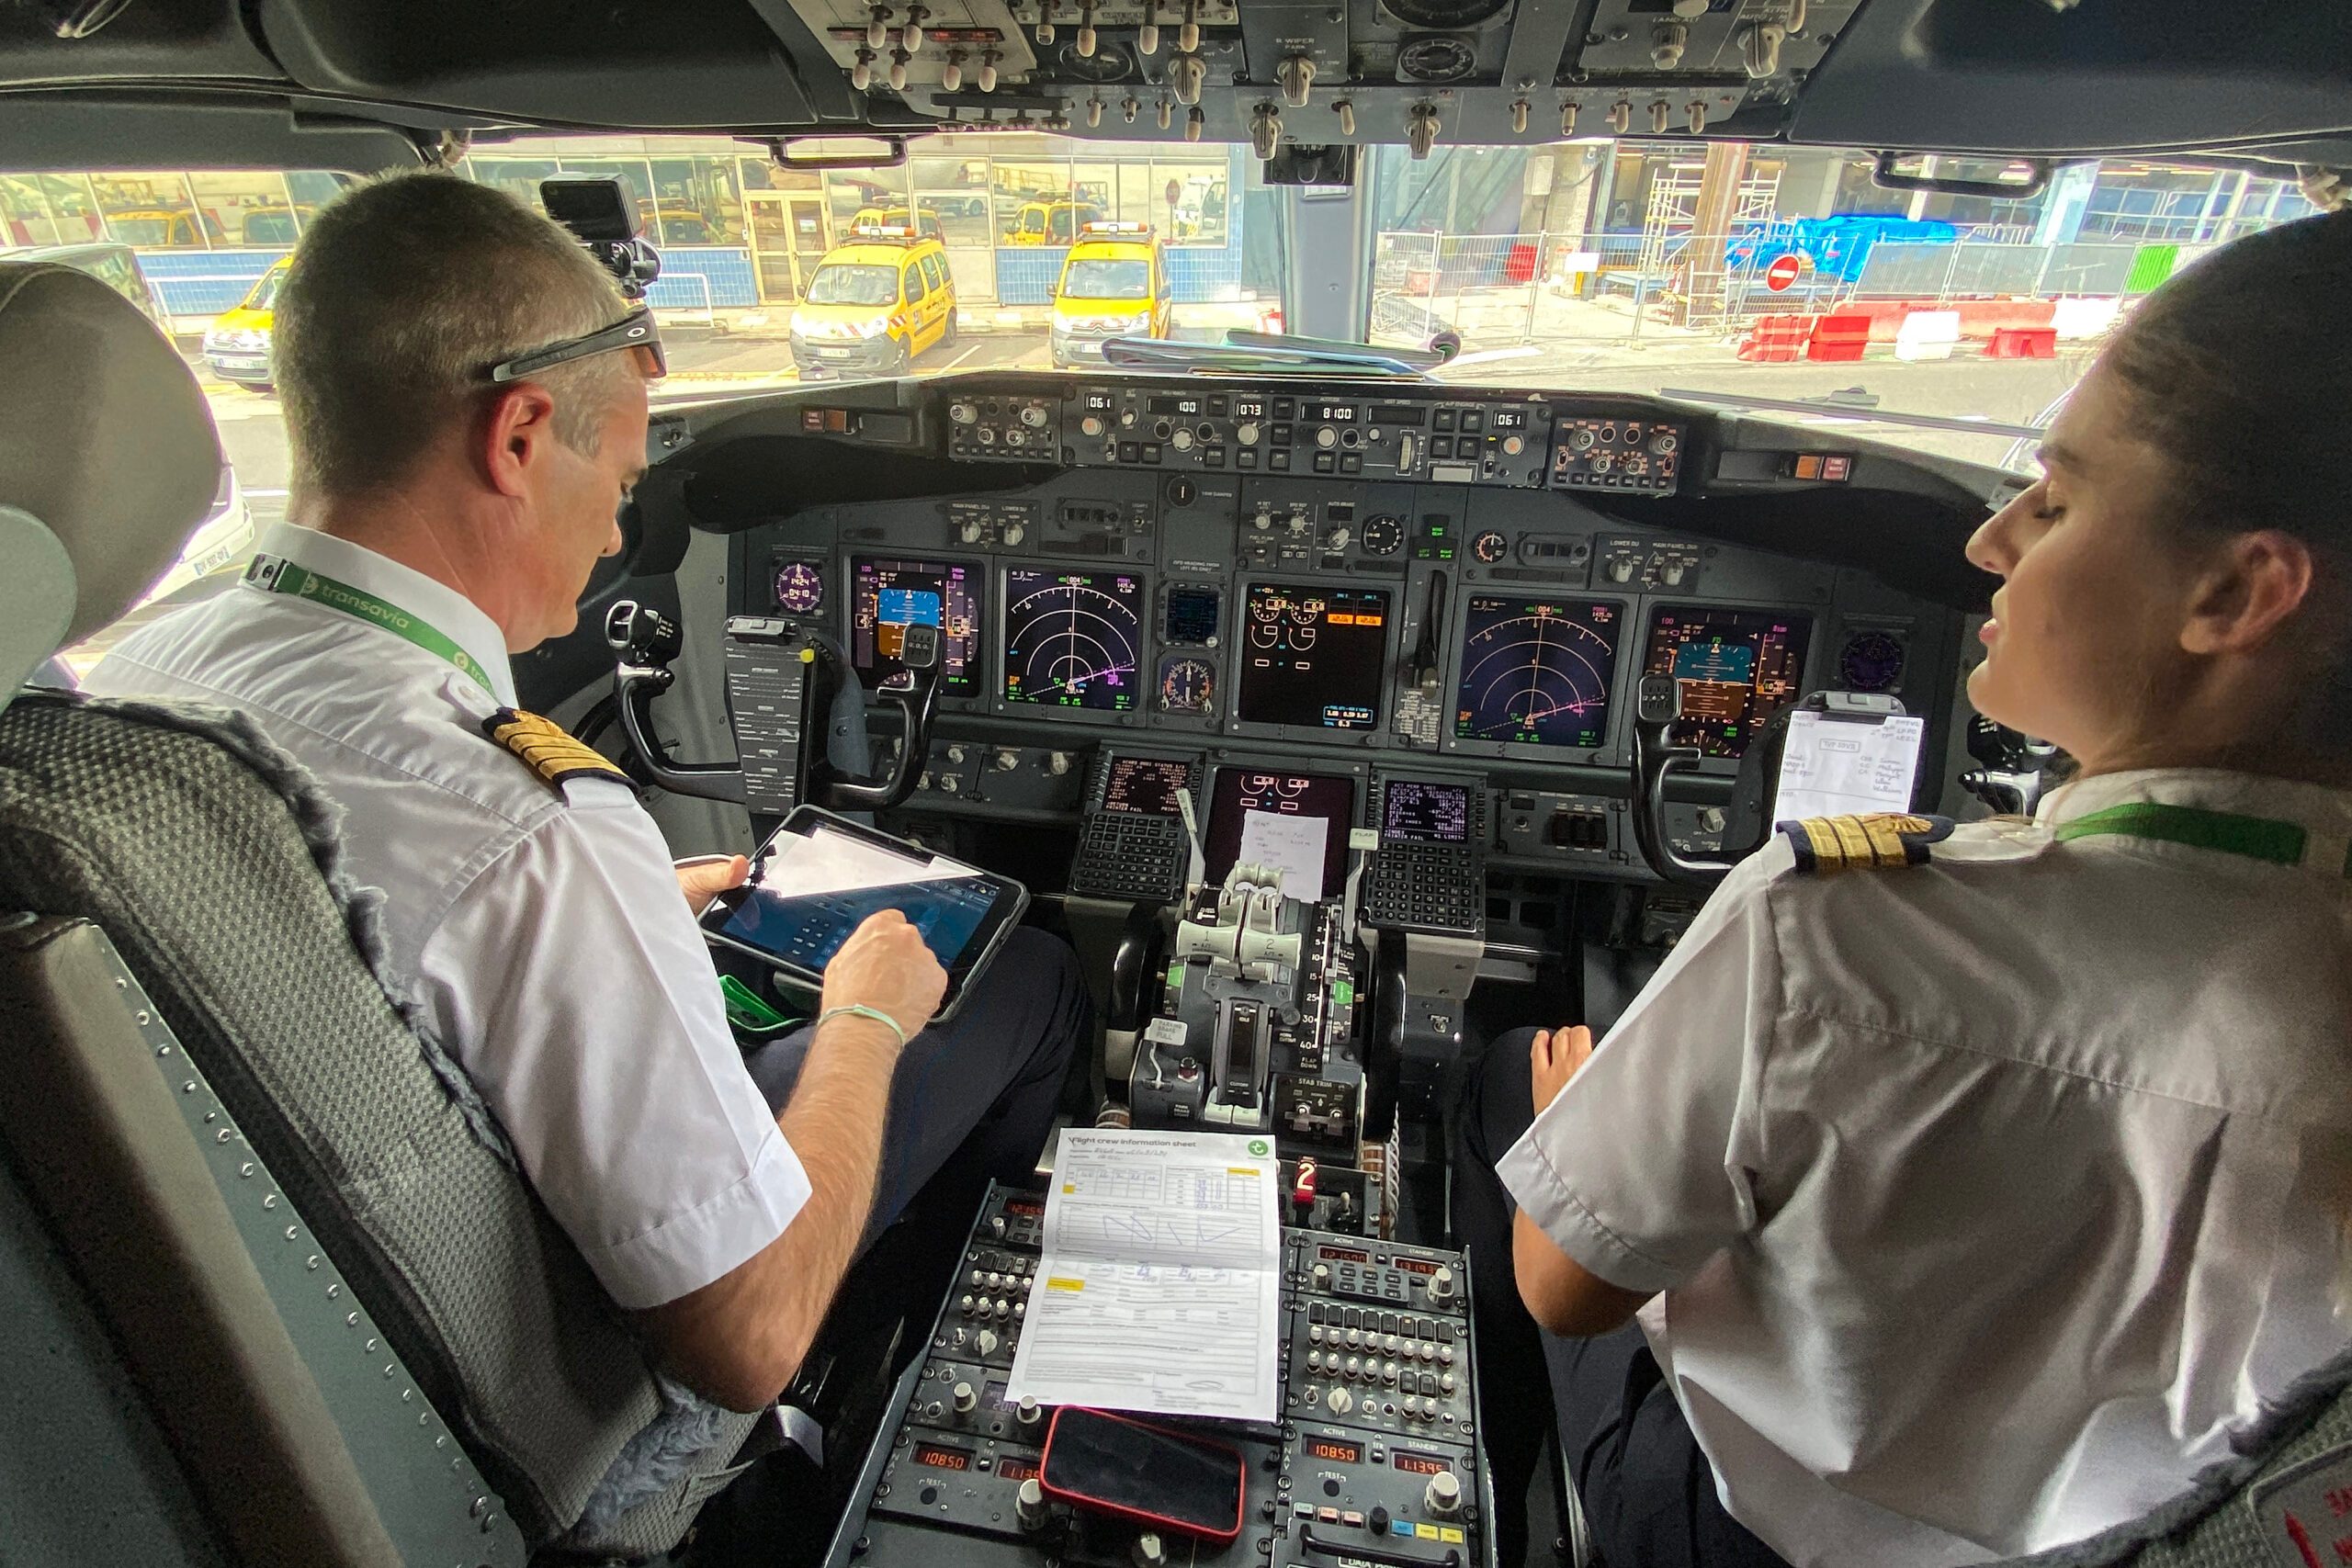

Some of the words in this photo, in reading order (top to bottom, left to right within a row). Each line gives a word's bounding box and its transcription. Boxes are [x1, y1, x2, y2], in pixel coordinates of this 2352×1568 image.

[1090, 397, 1111, 409] 061
[1179, 401, 1196, 412] 100
[1240, 404, 1261, 415] 073
[1323, 407, 1351, 419] 8100
[1498, 414, 1521, 425] 061
[322, 584, 410, 629] transavia
[1265, 938, 1275, 950] 2
[1312, 953, 1320, 962] 10
[1309, 972, 1317, 980] 15
[1306, 993, 1317, 1002] 25
[1302, 1015, 1314, 1023] 30
[1299, 1041, 1312, 1049] 40
[1298, 1077, 1315, 1086] STAB
[1073, 1137, 1096, 1145] Flight
[1120, 1137, 1170, 1147] information
[1172, 1139, 1197, 1147] sheet
[1296, 1162, 1316, 1190] 2
[1333, 1236, 1354, 1246] ACTIVE
[1322, 1427, 1346, 1438] ACTIVE
[936, 1434, 959, 1444] ACTIVE
[1408, 1440, 1439, 1451] STANDBY
[1324, 1471, 1341, 1480] TEST
[925, 1477, 943, 1486] TEST
